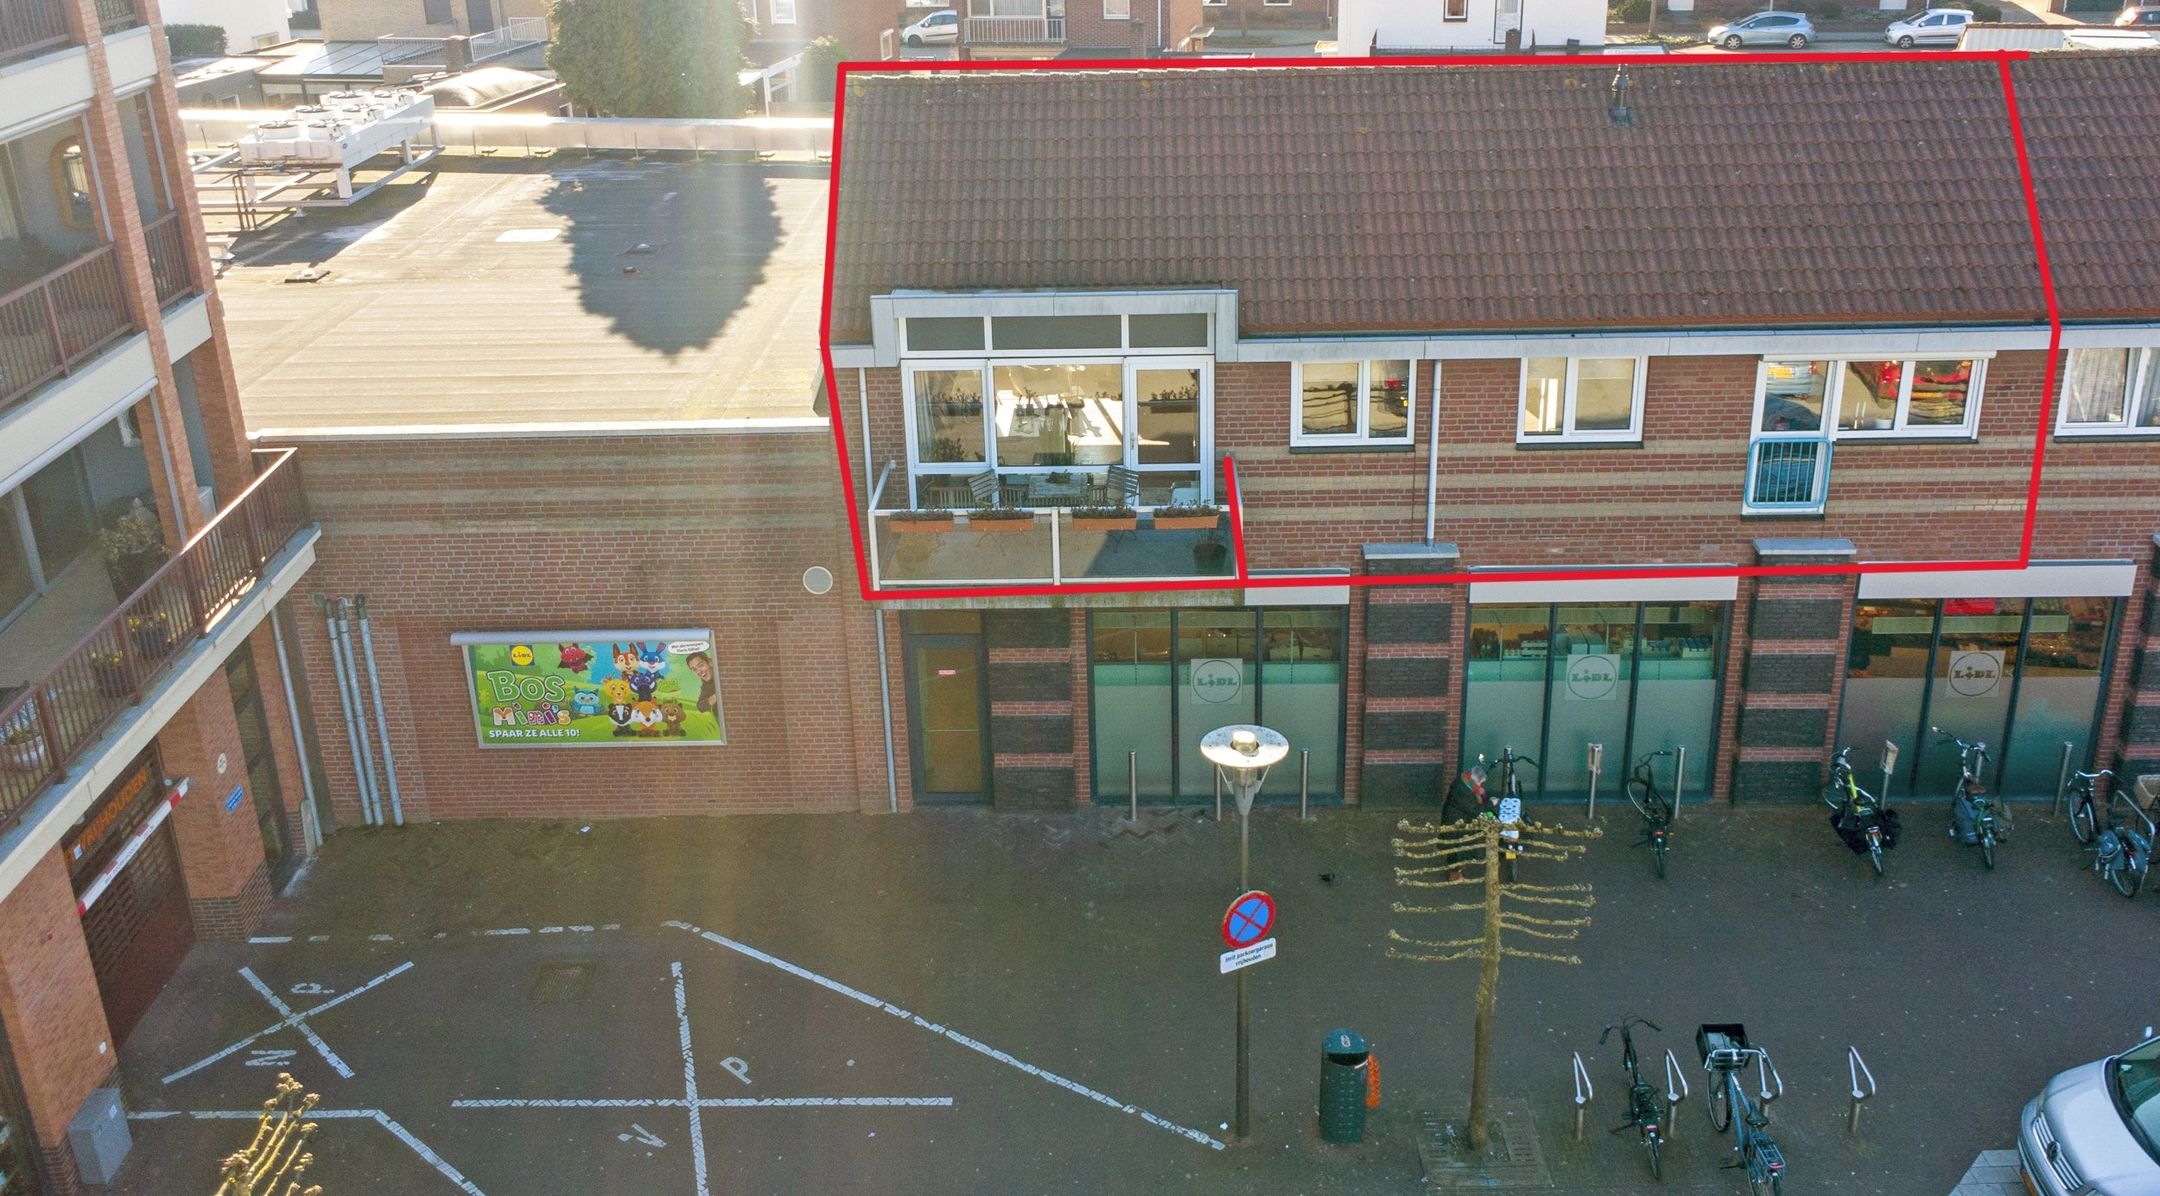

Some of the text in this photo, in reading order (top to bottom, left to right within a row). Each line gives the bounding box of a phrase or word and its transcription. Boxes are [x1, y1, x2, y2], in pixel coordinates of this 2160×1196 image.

[489, 728, 580, 738] SPAAR ZE ALLE 10!
[720, 1056, 752, 1085] P
